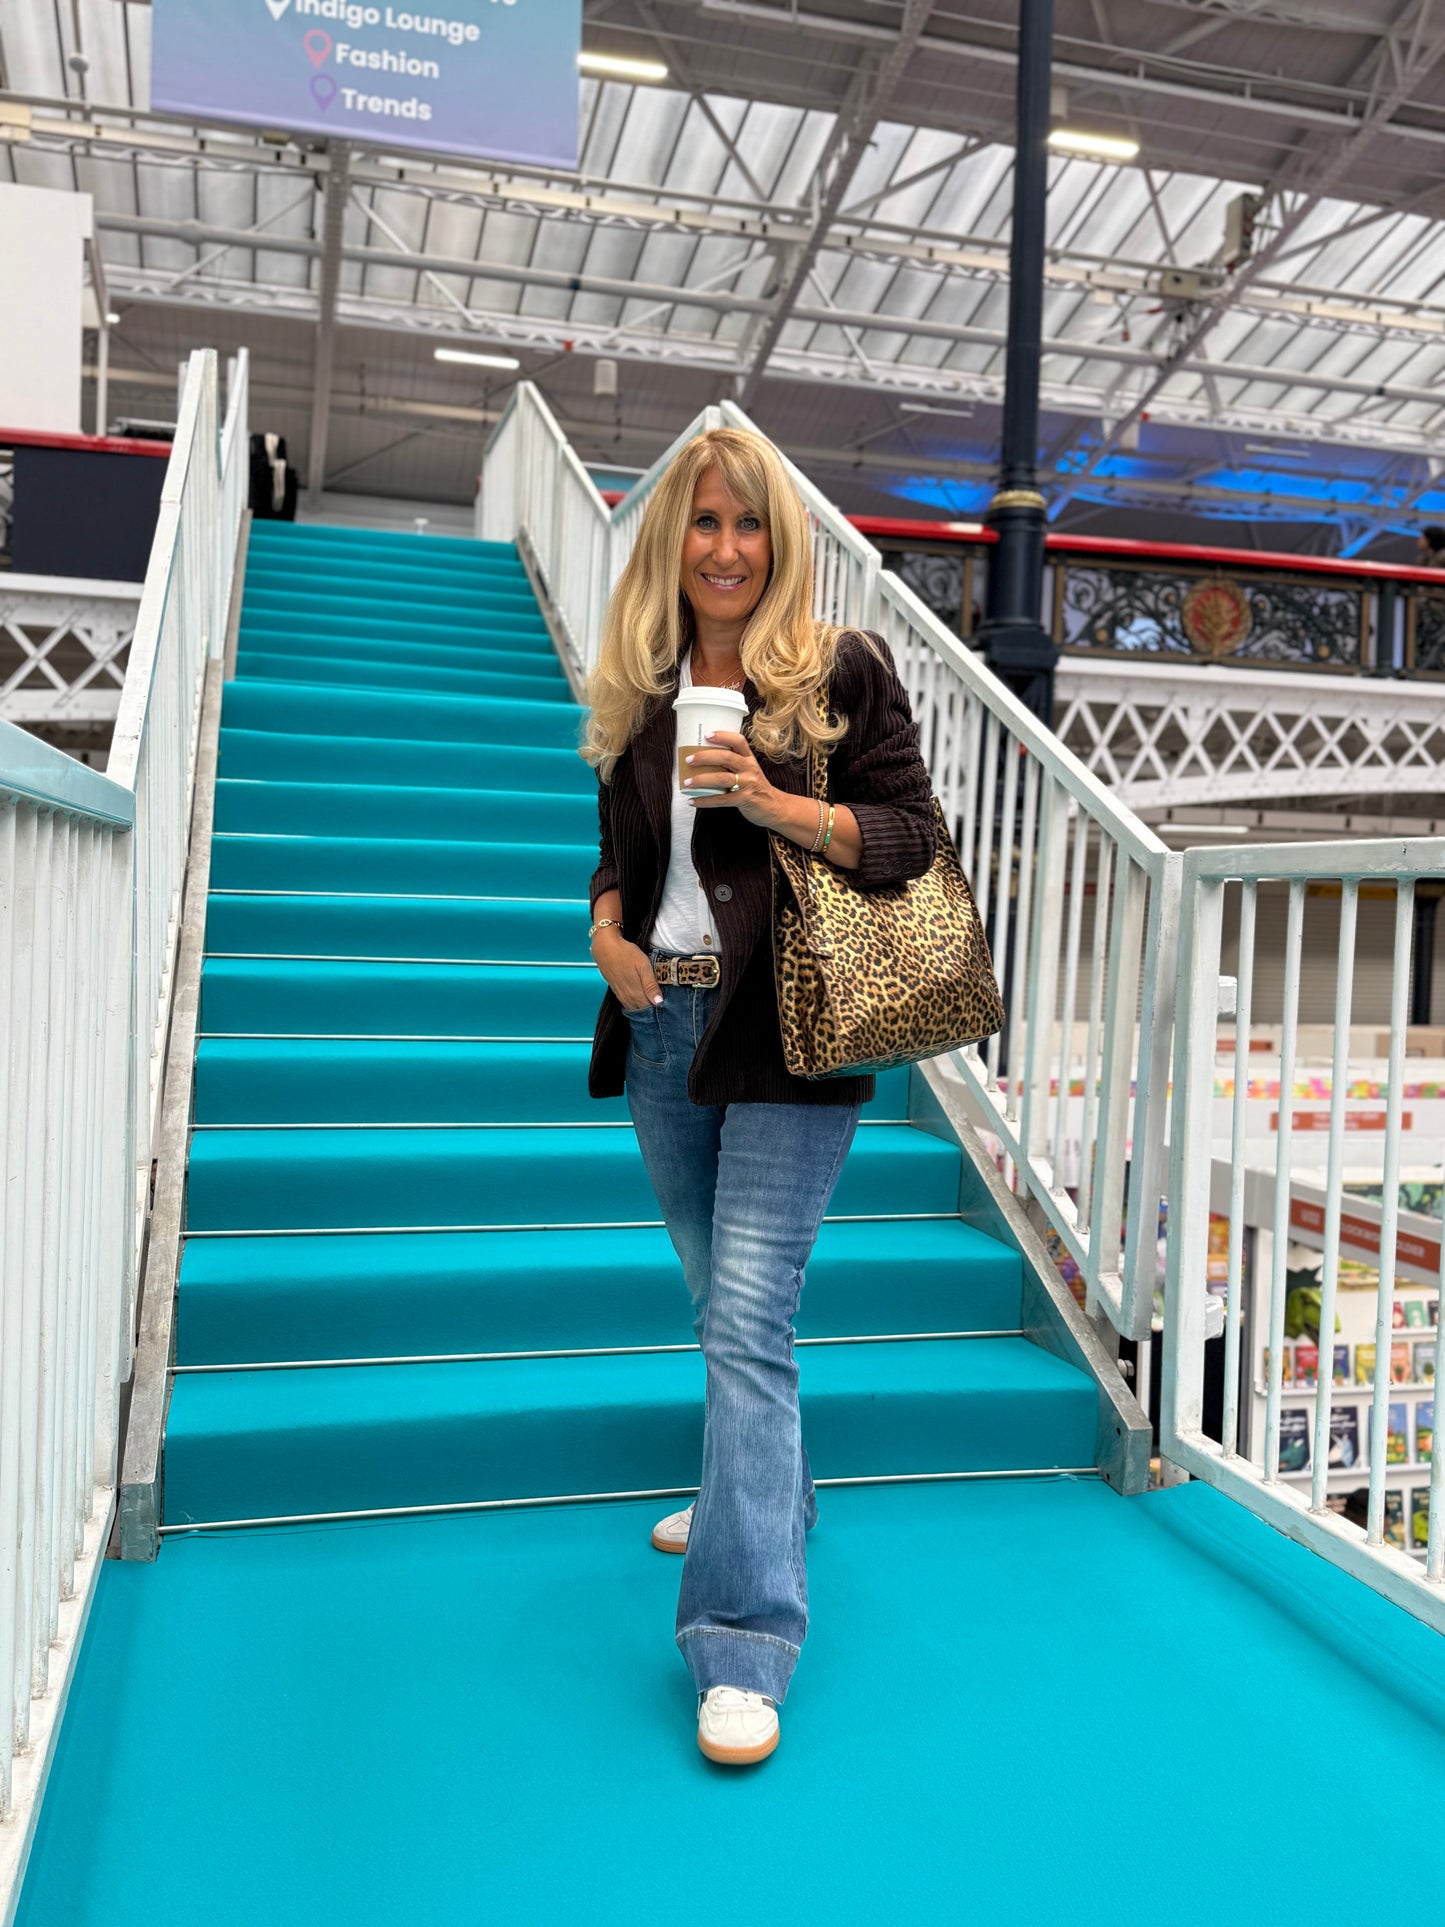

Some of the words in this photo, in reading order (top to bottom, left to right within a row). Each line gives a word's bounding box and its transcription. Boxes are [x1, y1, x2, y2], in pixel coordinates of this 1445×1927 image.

[295, 0, 380, 29] Indigo
[385, 7, 480, 45] Lounge
[335, 43, 440, 79] Fashion
[341, 87, 432, 120] Trends
